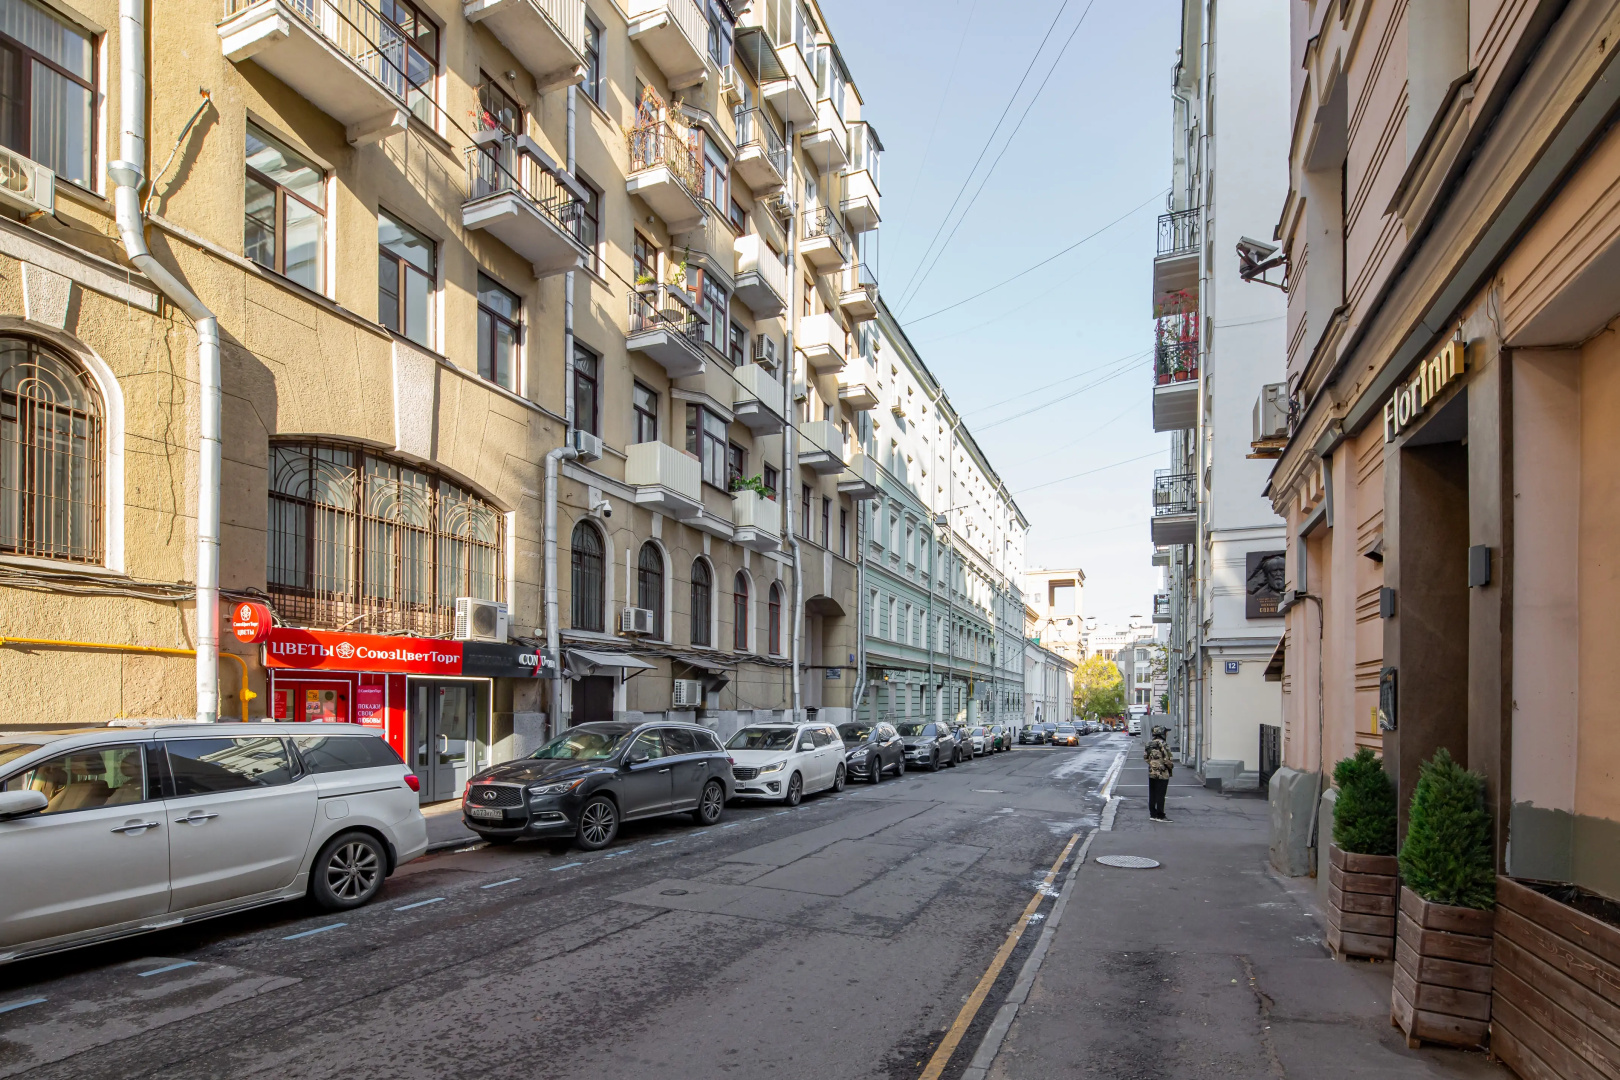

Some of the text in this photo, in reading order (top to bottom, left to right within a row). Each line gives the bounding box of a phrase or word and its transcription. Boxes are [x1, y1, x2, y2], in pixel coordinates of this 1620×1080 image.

[1383, 340, 1464, 444] Florinn
[271, 641, 334, 657] ЦВЕТЫ
[356, 646, 460, 664] СоюзЦветТорг
